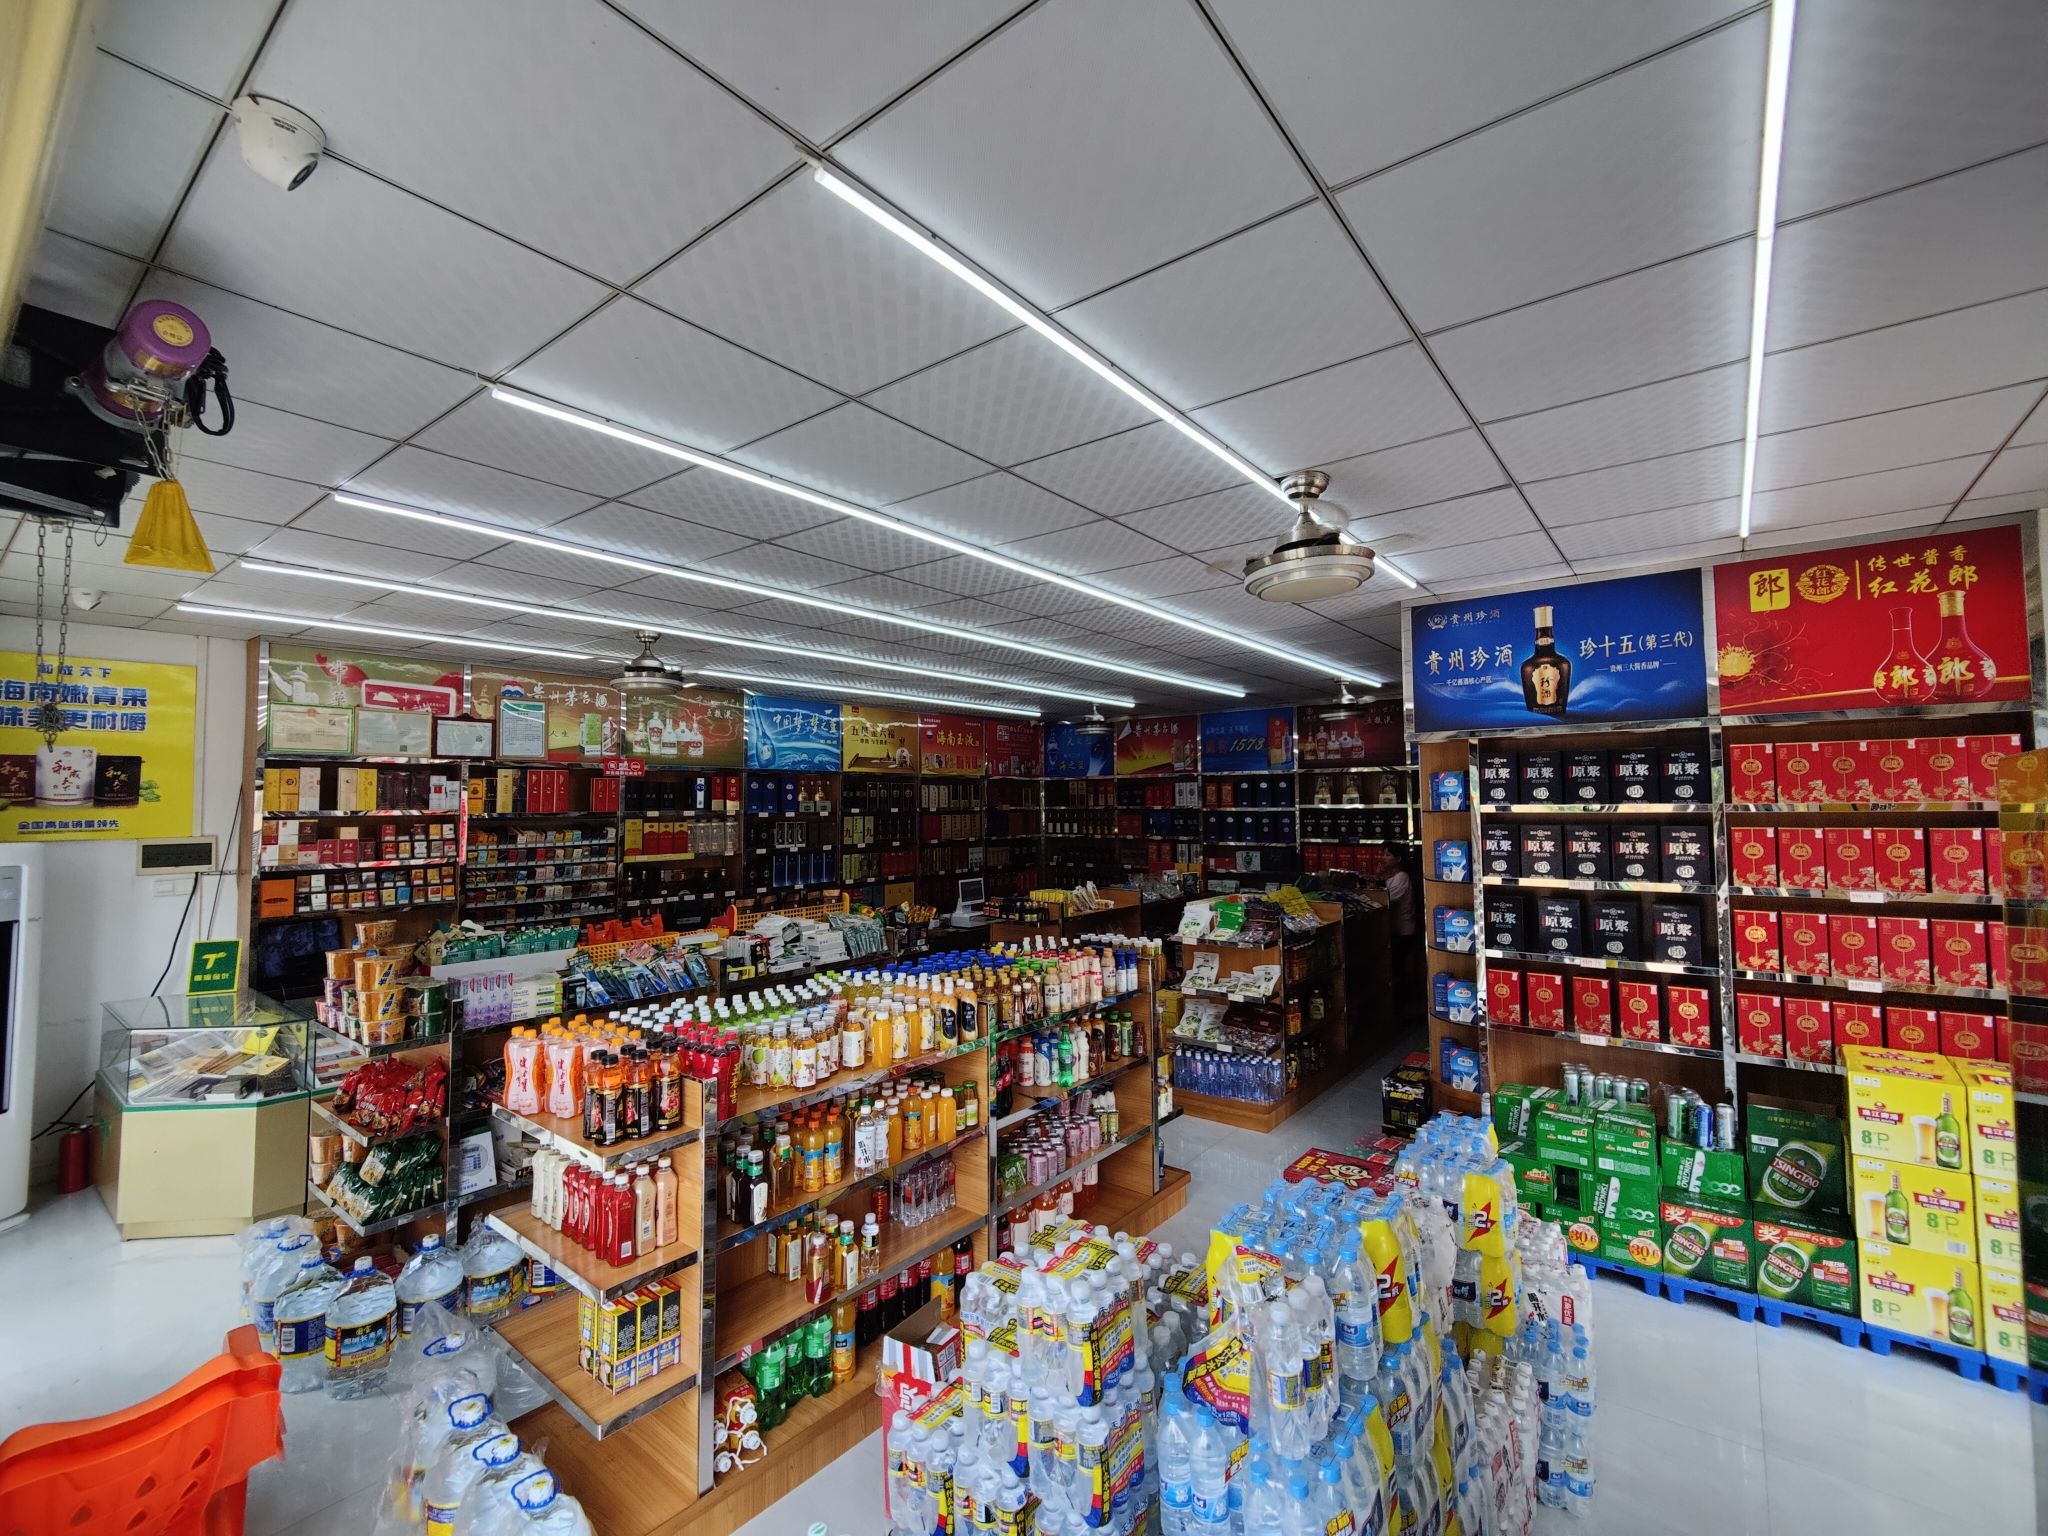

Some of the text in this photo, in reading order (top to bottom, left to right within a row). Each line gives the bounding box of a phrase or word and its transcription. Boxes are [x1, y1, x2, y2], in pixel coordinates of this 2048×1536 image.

[1868, 564, 1979, 599] 红花郎
[1754, 573, 1785, 608] 郎
[1938, 656, 1975, 697] 郎
[1229, 737, 1266, 752] 1573
[1484, 767, 1510, 779] 原浆
[1526, 767, 1554, 779] 原浆
[1571, 766, 1600, 778] 原浆
[1618, 764, 1649, 776] 原浆
[1668, 763, 1700, 775] 原浆
[18, 819, 119, 831] 全国高端销量领先
[1486, 840, 1512, 851] 原浆
[1527, 840, 1555, 852] 原浆
[1572, 841, 1601, 853] 原浆
[1618, 842, 1649, 854] 原浆
[1669, 842, 1701, 855] 原浆
[1490, 912, 1516, 924] 原浆
[1545, 915, 1572, 928] 原浆
[1600, 919, 1629, 932] 原浆
[1661, 923, 1692, 937] 原浆
[1682, 1157, 1693, 1188] TSINGTAO
[1772, 1156, 1820, 1188] TSINGTAO
[1598, 1183, 1609, 1214] TSINGTAO
[1672, 1233, 1705, 1256] TSINGTAO
[1766, 1253, 1803, 1280] TSINGTAO
